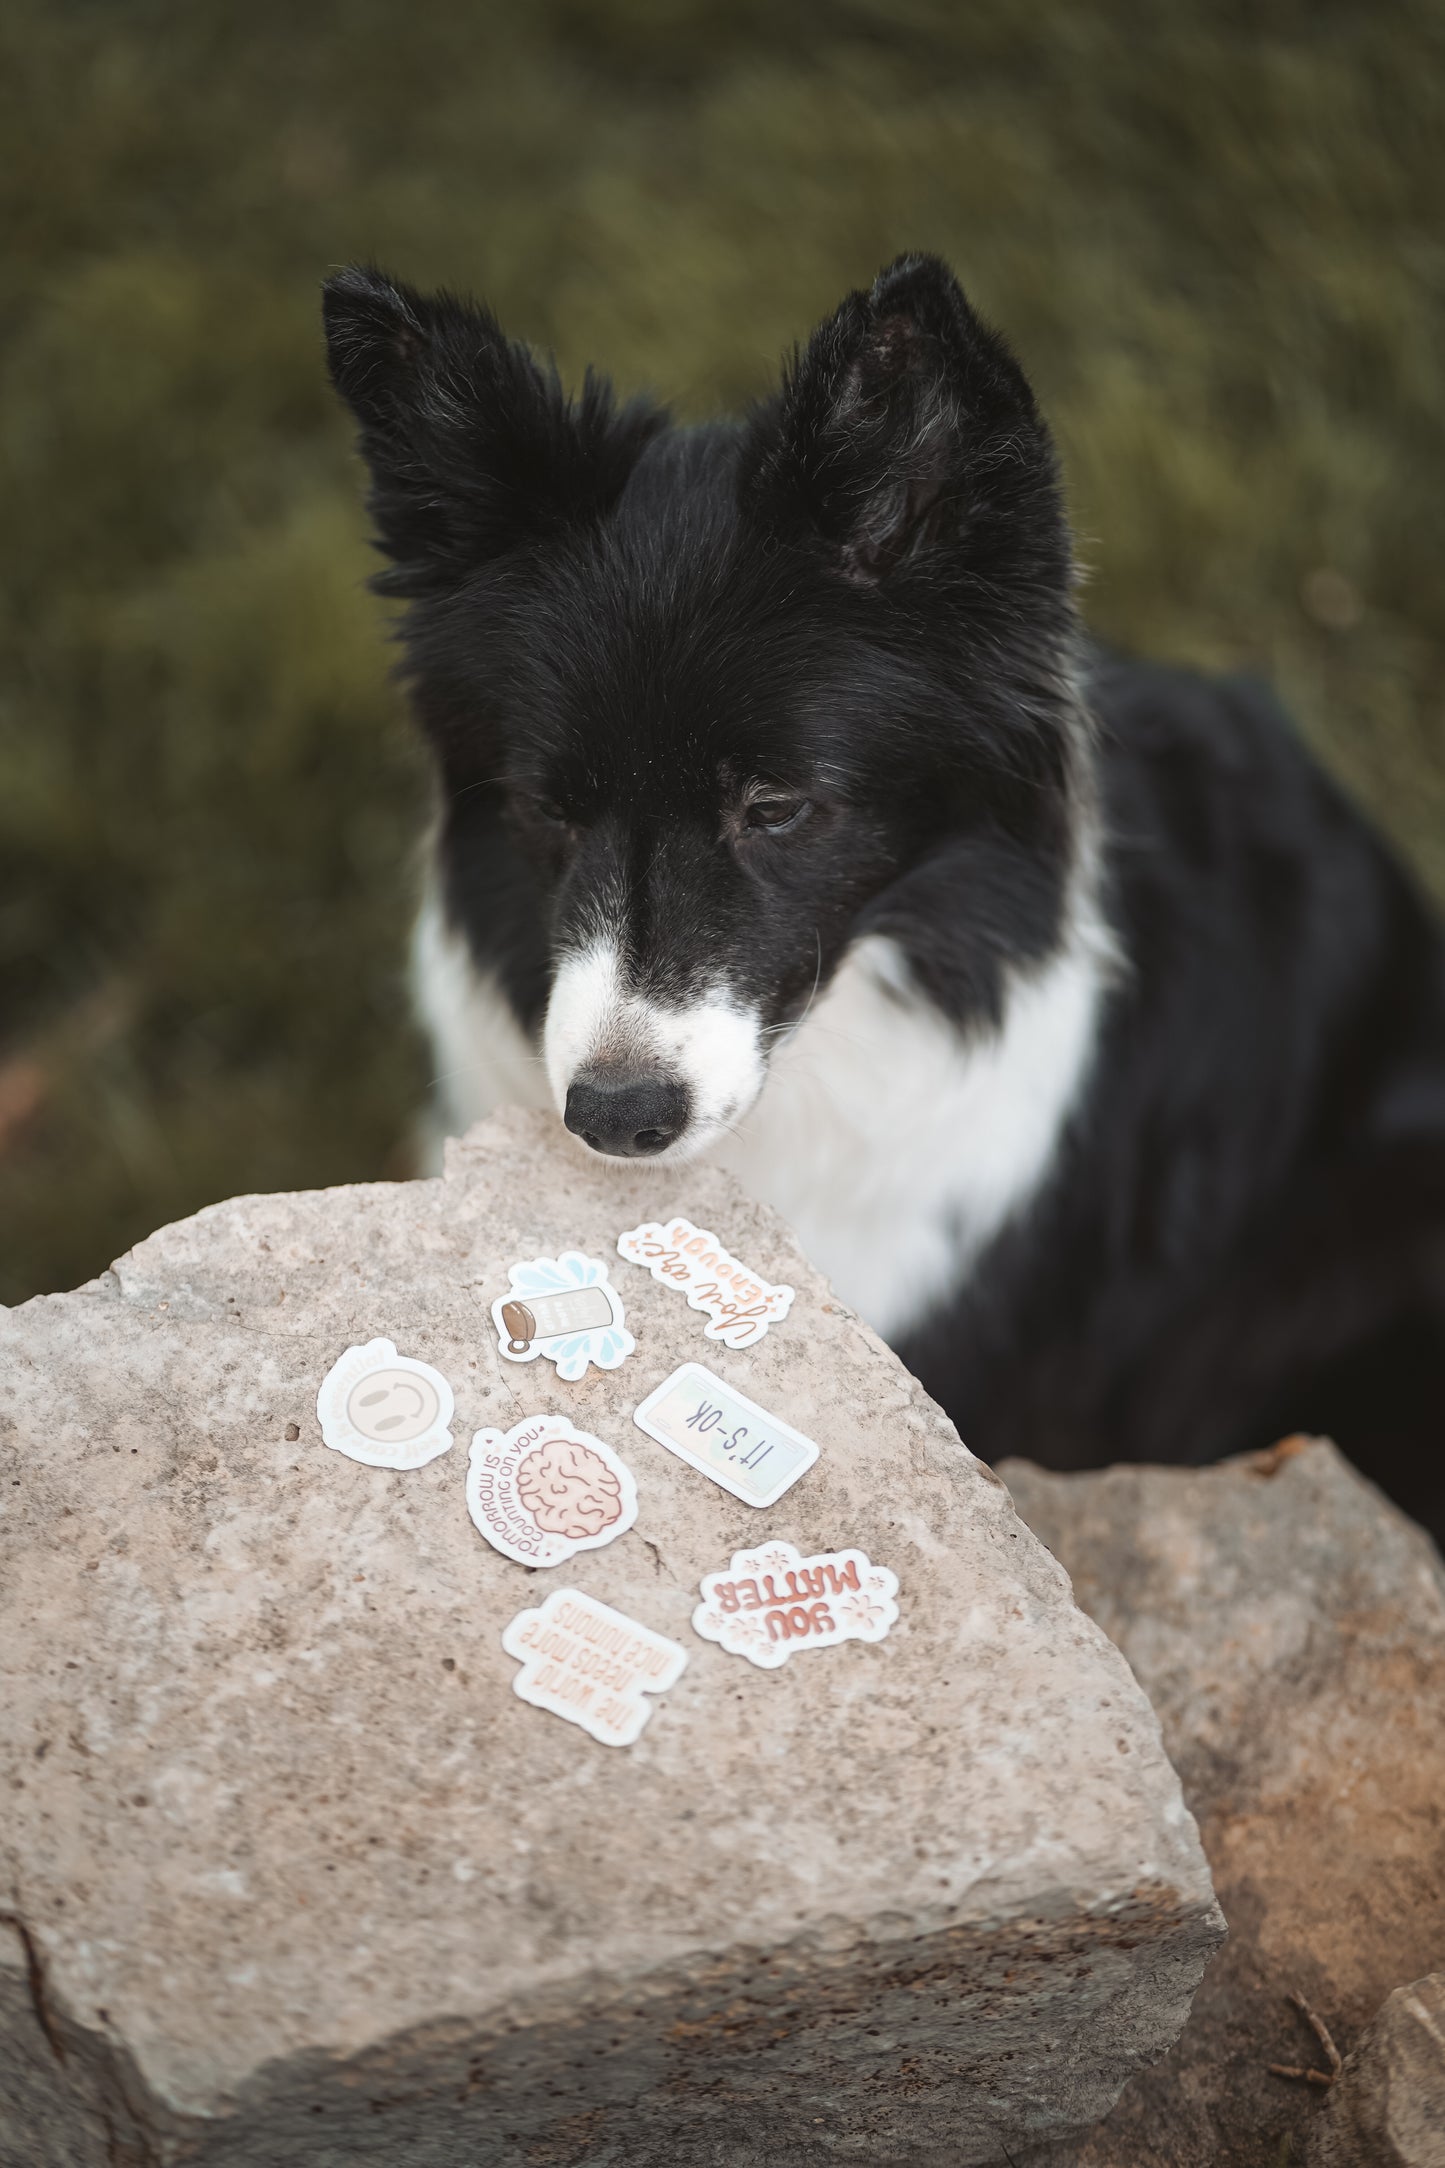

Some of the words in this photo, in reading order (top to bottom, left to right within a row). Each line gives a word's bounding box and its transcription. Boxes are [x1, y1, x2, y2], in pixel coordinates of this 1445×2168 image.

[641, 1242, 691, 1281] are
[671, 1226, 763, 1305] Enough
[694, 1282, 768, 1340] You
[483, 1454, 501, 1469] IS
[509, 1428, 539, 1455] YOU
[479, 1473, 540, 1557] TOMORROW
[714, 1560, 861, 1613] MATTER
[519, 1621, 577, 1663] more
[764, 1602, 836, 1641] YOU
[571, 1648, 634, 1692] needs
[623, 1641, 673, 1677] nice
[532, 1664, 595, 1710] world
